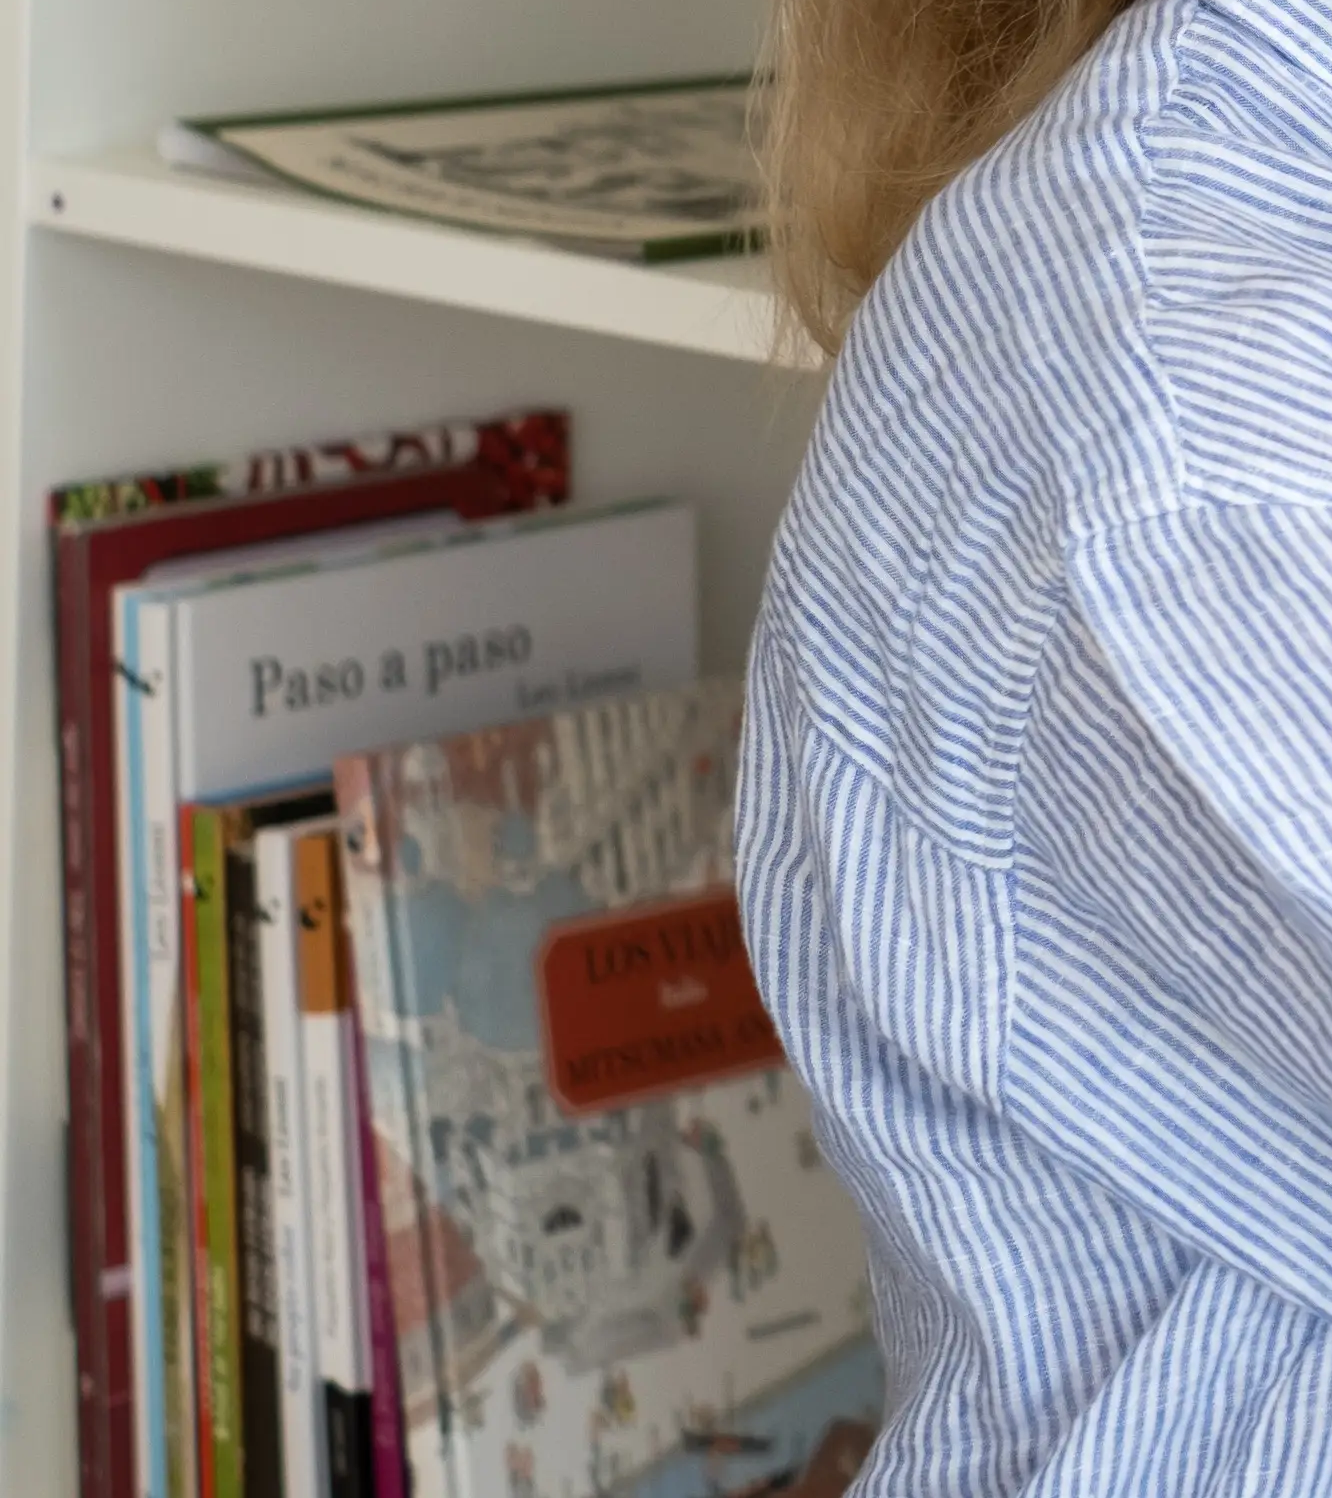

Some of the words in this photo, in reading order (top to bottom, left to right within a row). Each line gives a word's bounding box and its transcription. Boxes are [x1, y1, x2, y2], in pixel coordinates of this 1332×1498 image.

[249, 653, 366, 719] Paso
[379, 657, 409, 690] a
[424, 624, 533, 694] paso
